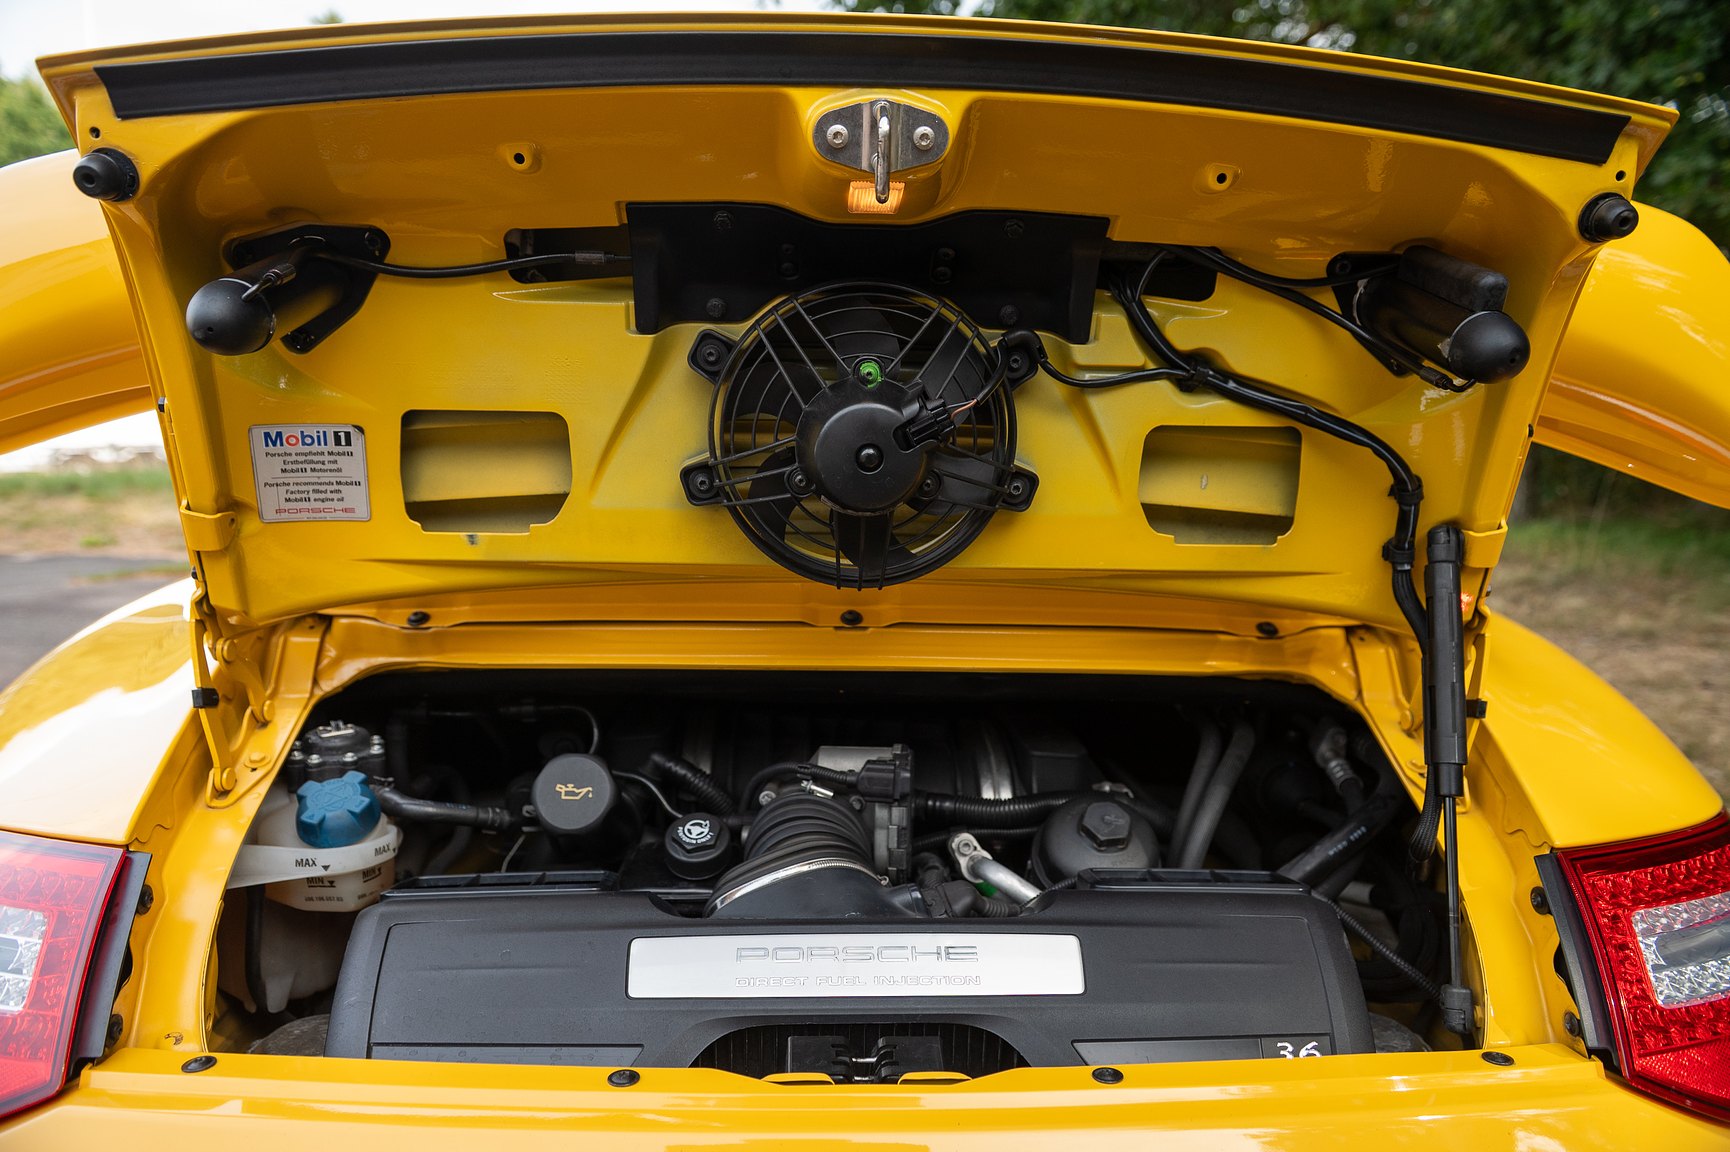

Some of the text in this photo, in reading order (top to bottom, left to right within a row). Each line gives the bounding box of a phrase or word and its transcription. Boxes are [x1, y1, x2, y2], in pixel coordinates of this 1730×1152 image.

[263, 430, 328, 447] Mobil
[374, 843, 391, 857] MAX
[295, 857, 318, 868] MAX
[306, 877, 324, 885] MIN
[736, 946, 979, 963] PORSCHE
[736, 975, 981, 987] DIRECT FUEL INJECTION
